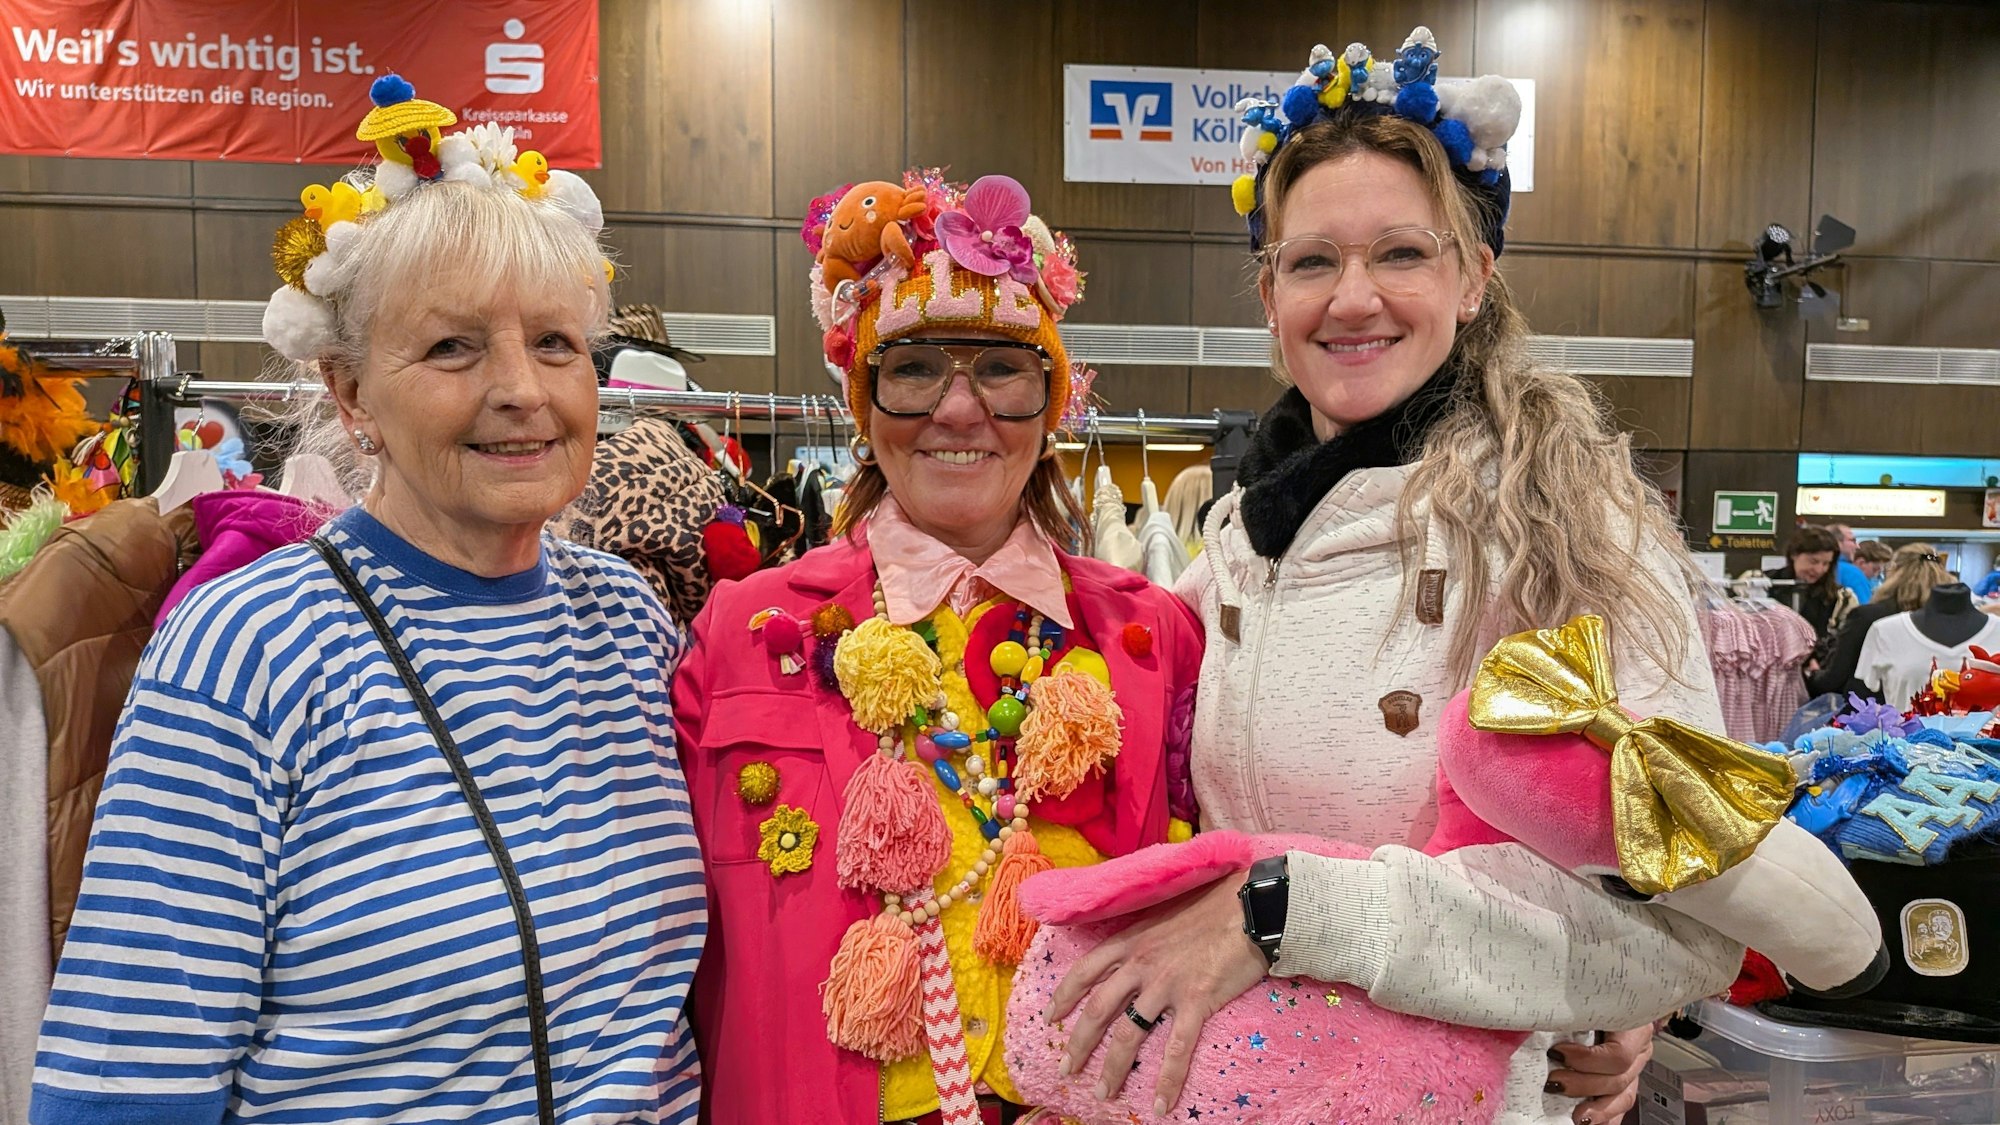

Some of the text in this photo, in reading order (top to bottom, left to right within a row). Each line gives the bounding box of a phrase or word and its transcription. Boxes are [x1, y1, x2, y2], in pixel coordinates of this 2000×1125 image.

[12, 26, 375, 81] Weil's wichtig ist.
[14, 77, 333, 111] Wir unterstützen die Region.
[462, 107, 568, 123] Kreissparkasse
[1191, 156, 1226, 173] Von
[1726, 535, 1775, 549] Toiletten
[1815, 1103, 1855, 1123] FOXY
